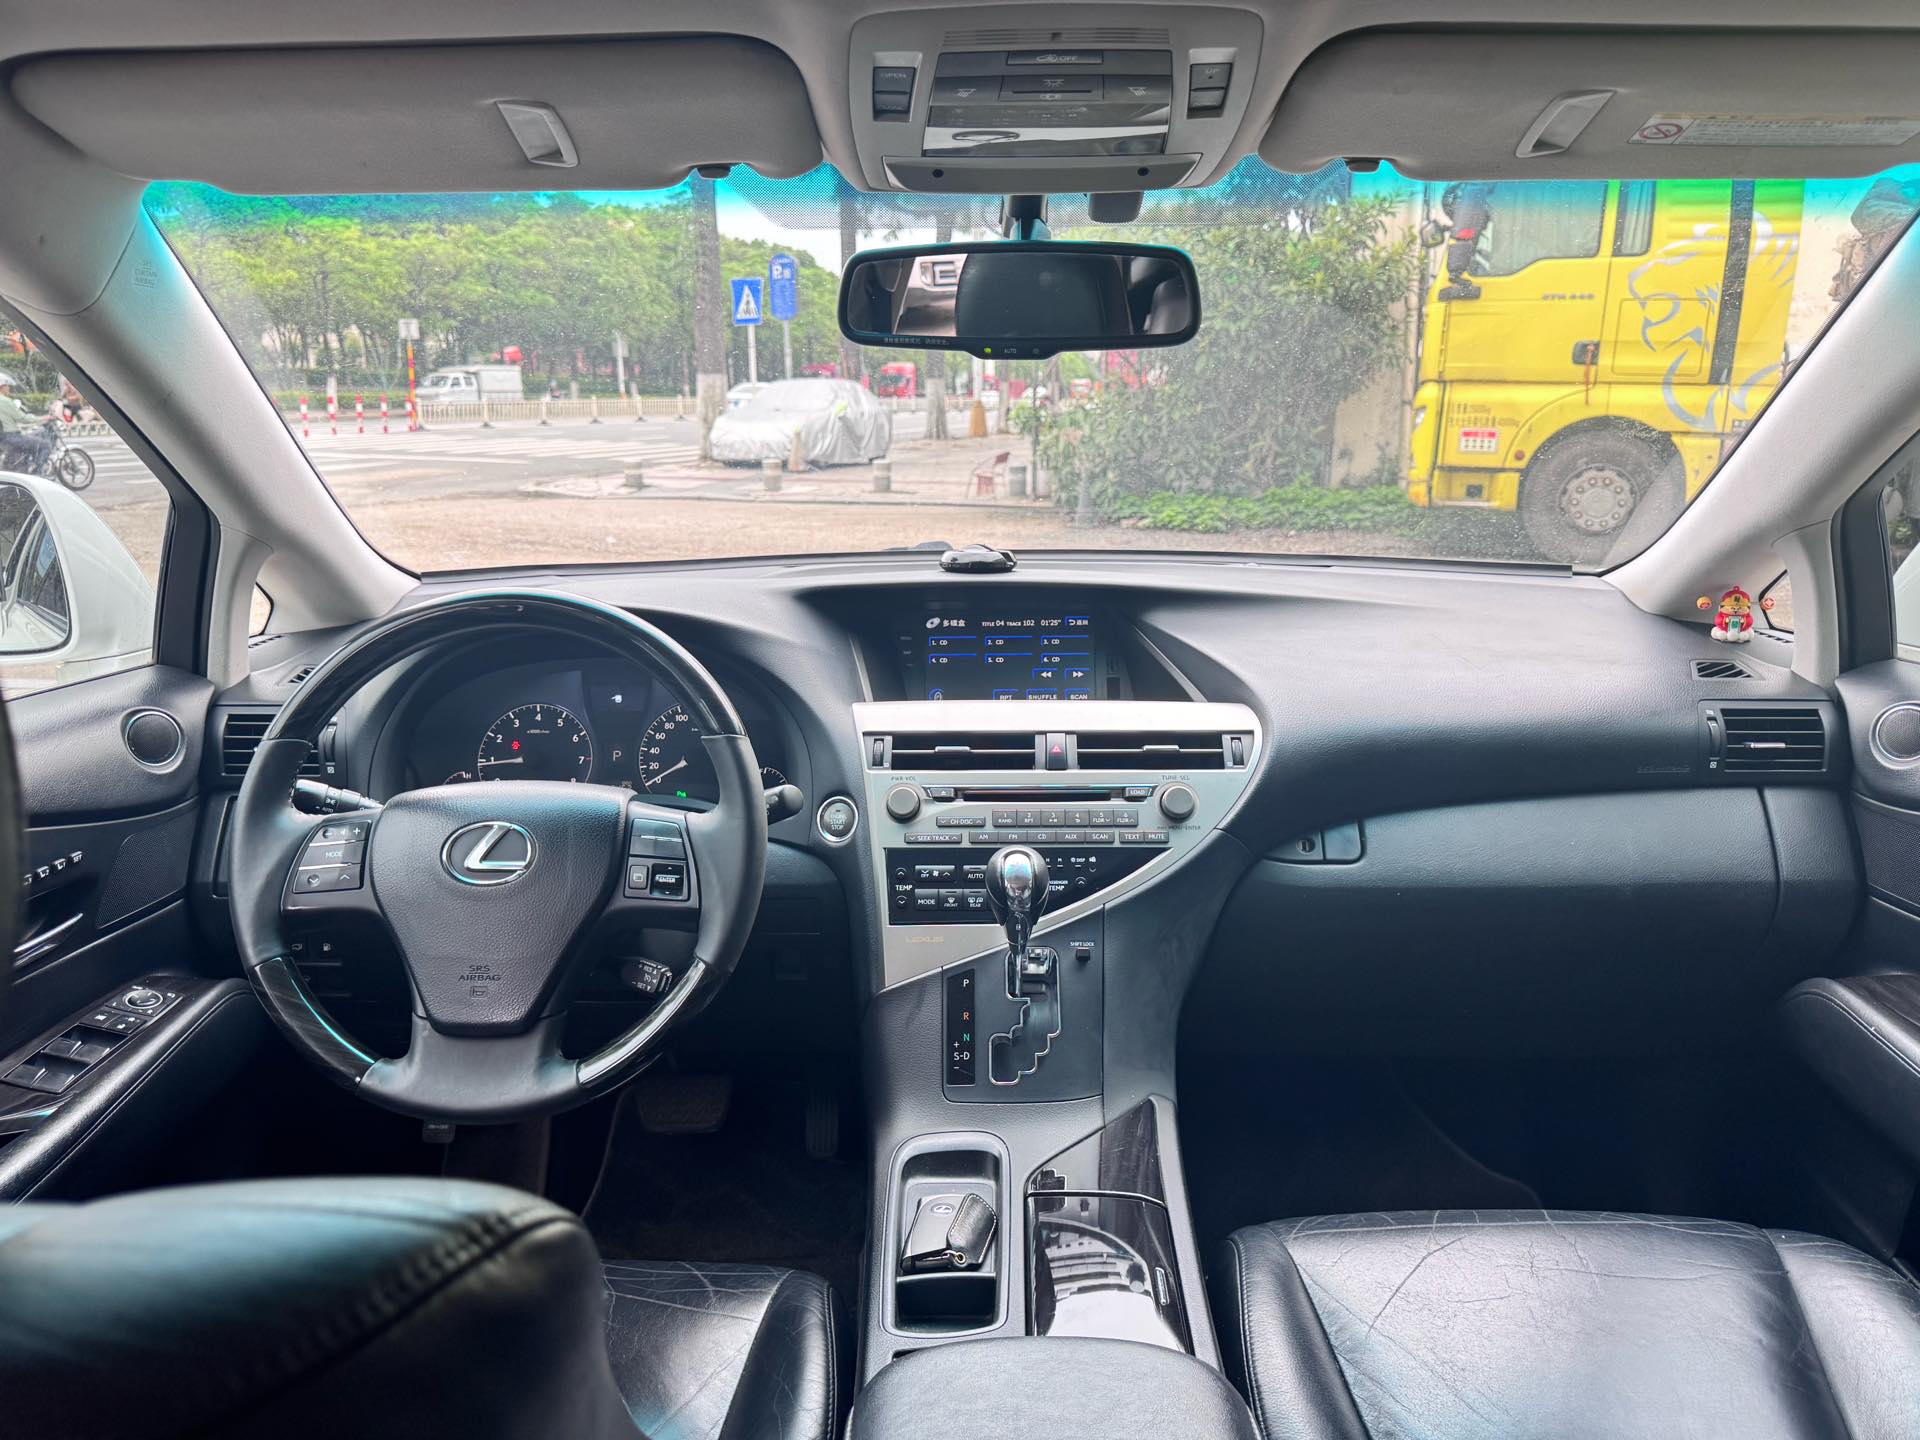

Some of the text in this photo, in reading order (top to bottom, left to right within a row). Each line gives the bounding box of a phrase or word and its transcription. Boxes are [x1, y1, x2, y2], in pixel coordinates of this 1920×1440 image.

[996, 619, 1005, 627] 04
[1023, 619, 1035, 627] 102
[675, 714, 689, 722] 100
[513, 719, 520, 727] 3
[557, 719, 564, 727] 5
[664, 722, 675, 730] 80
[496, 735, 503, 743] 2
[572, 734, 579, 743] 6
[655, 732, 666, 740] 60
[649, 747, 660, 755] 40
[612, 749, 622, 762] P
[578, 756, 584, 764] 7
[649, 762, 660, 770] 20
[458, 974, 502, 982] AIRBAG
[963, 979, 969, 987] P
[963, 1012, 970, 1020] R
[963, 1033, 970, 1041] N
